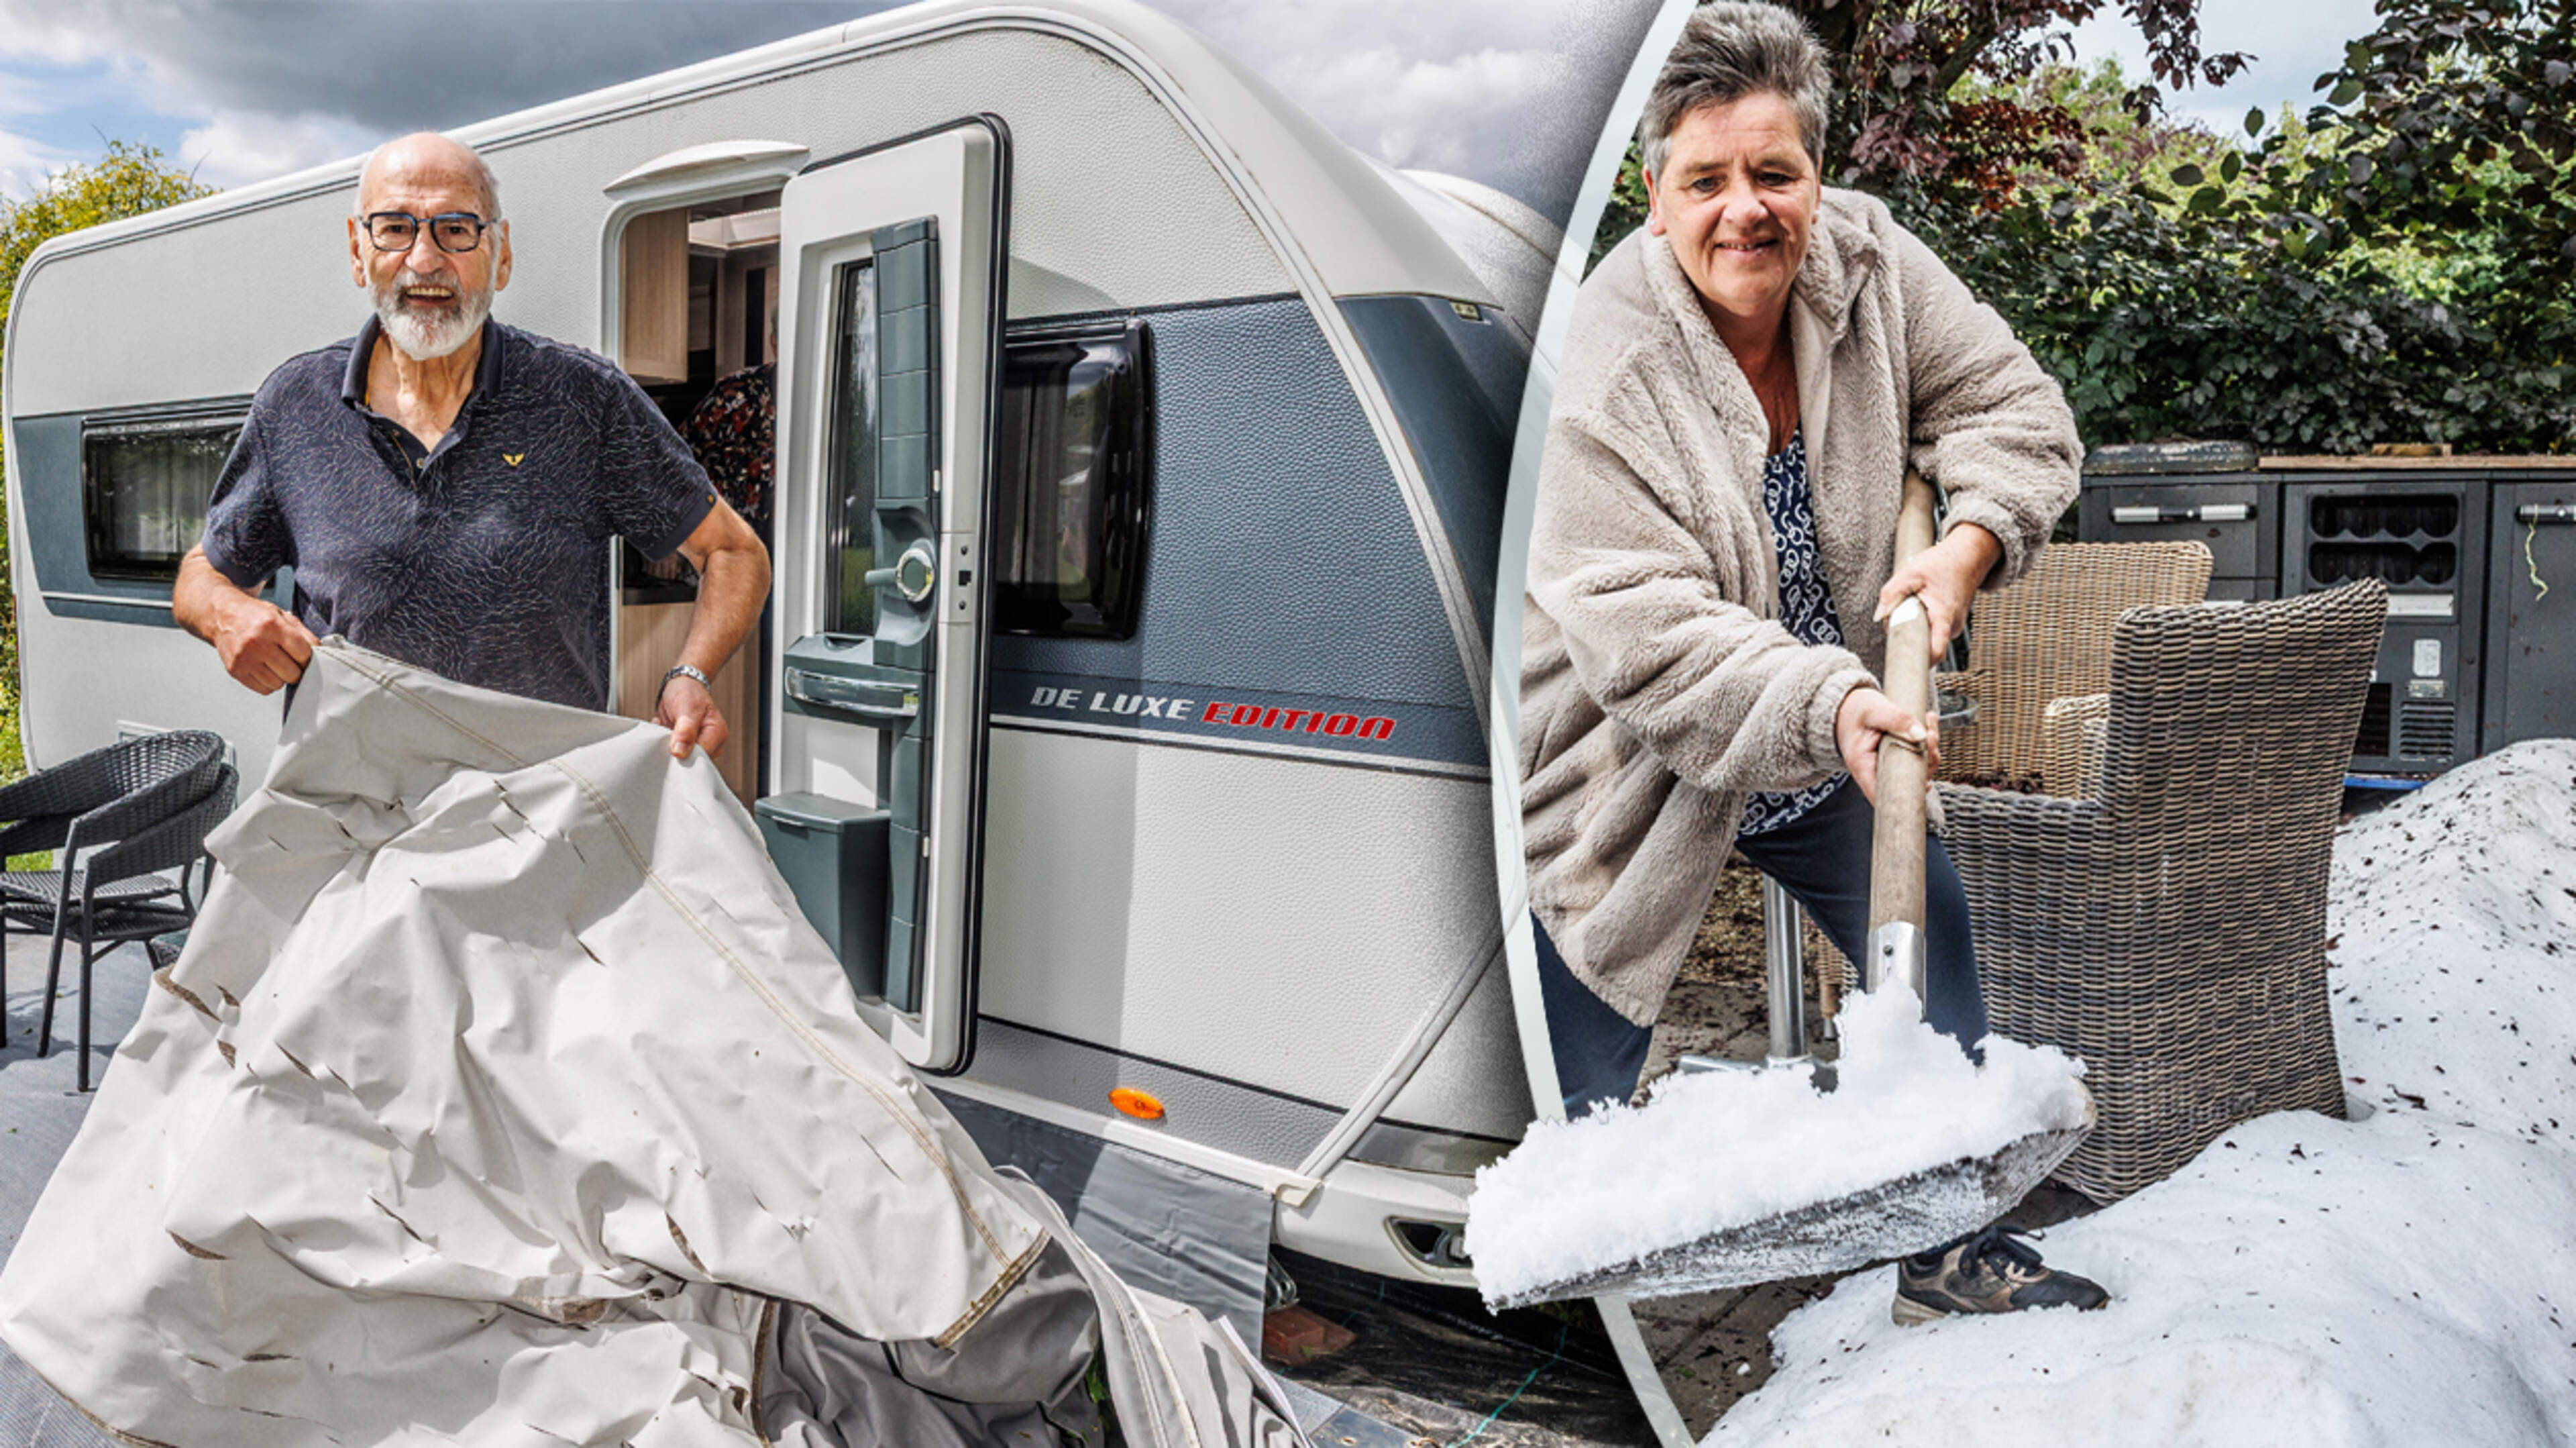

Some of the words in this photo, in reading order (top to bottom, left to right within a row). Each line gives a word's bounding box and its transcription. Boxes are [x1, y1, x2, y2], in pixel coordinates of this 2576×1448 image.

[1031, 686, 1083, 709] DE
[1089, 692, 1195, 721] LUXE
[1203, 701, 1397, 739] EDITION
